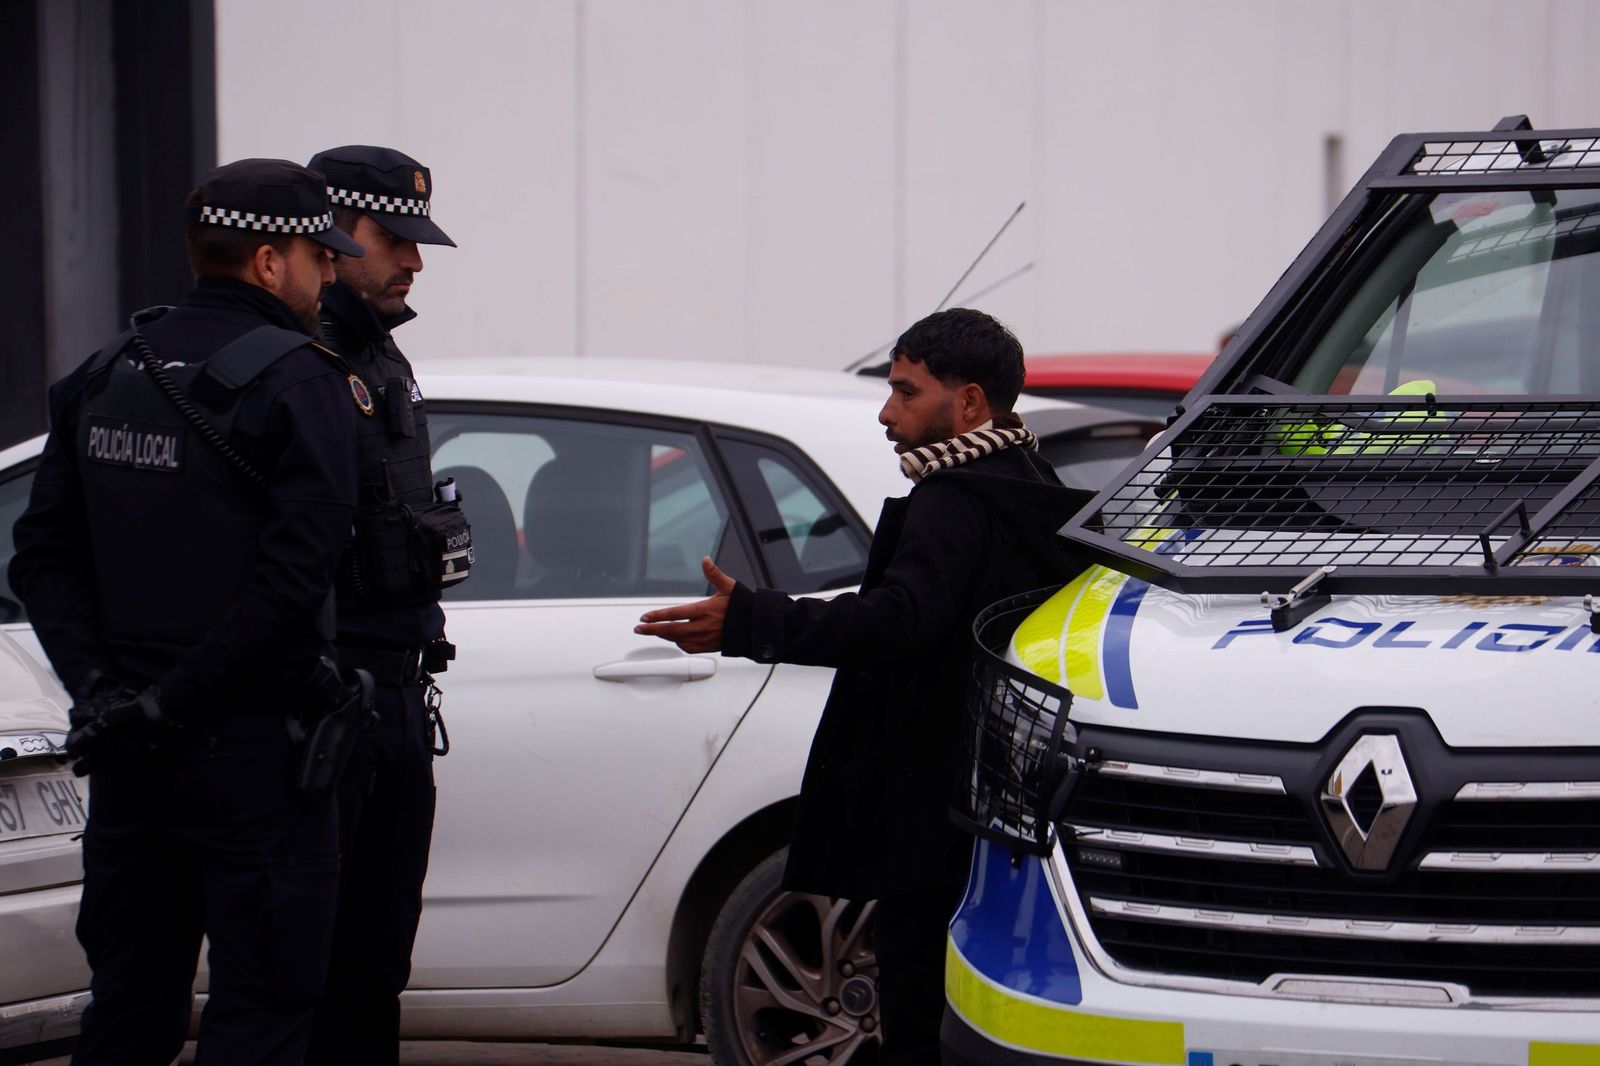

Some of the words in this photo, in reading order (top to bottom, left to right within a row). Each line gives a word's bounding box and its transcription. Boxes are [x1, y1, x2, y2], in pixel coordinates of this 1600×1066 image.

[88, 424, 134, 462] POLICÍA
[135, 432, 179, 468] LOCAL
[1212, 617, 1600, 652] POLICI
[0, 784, 26, 832] 67
